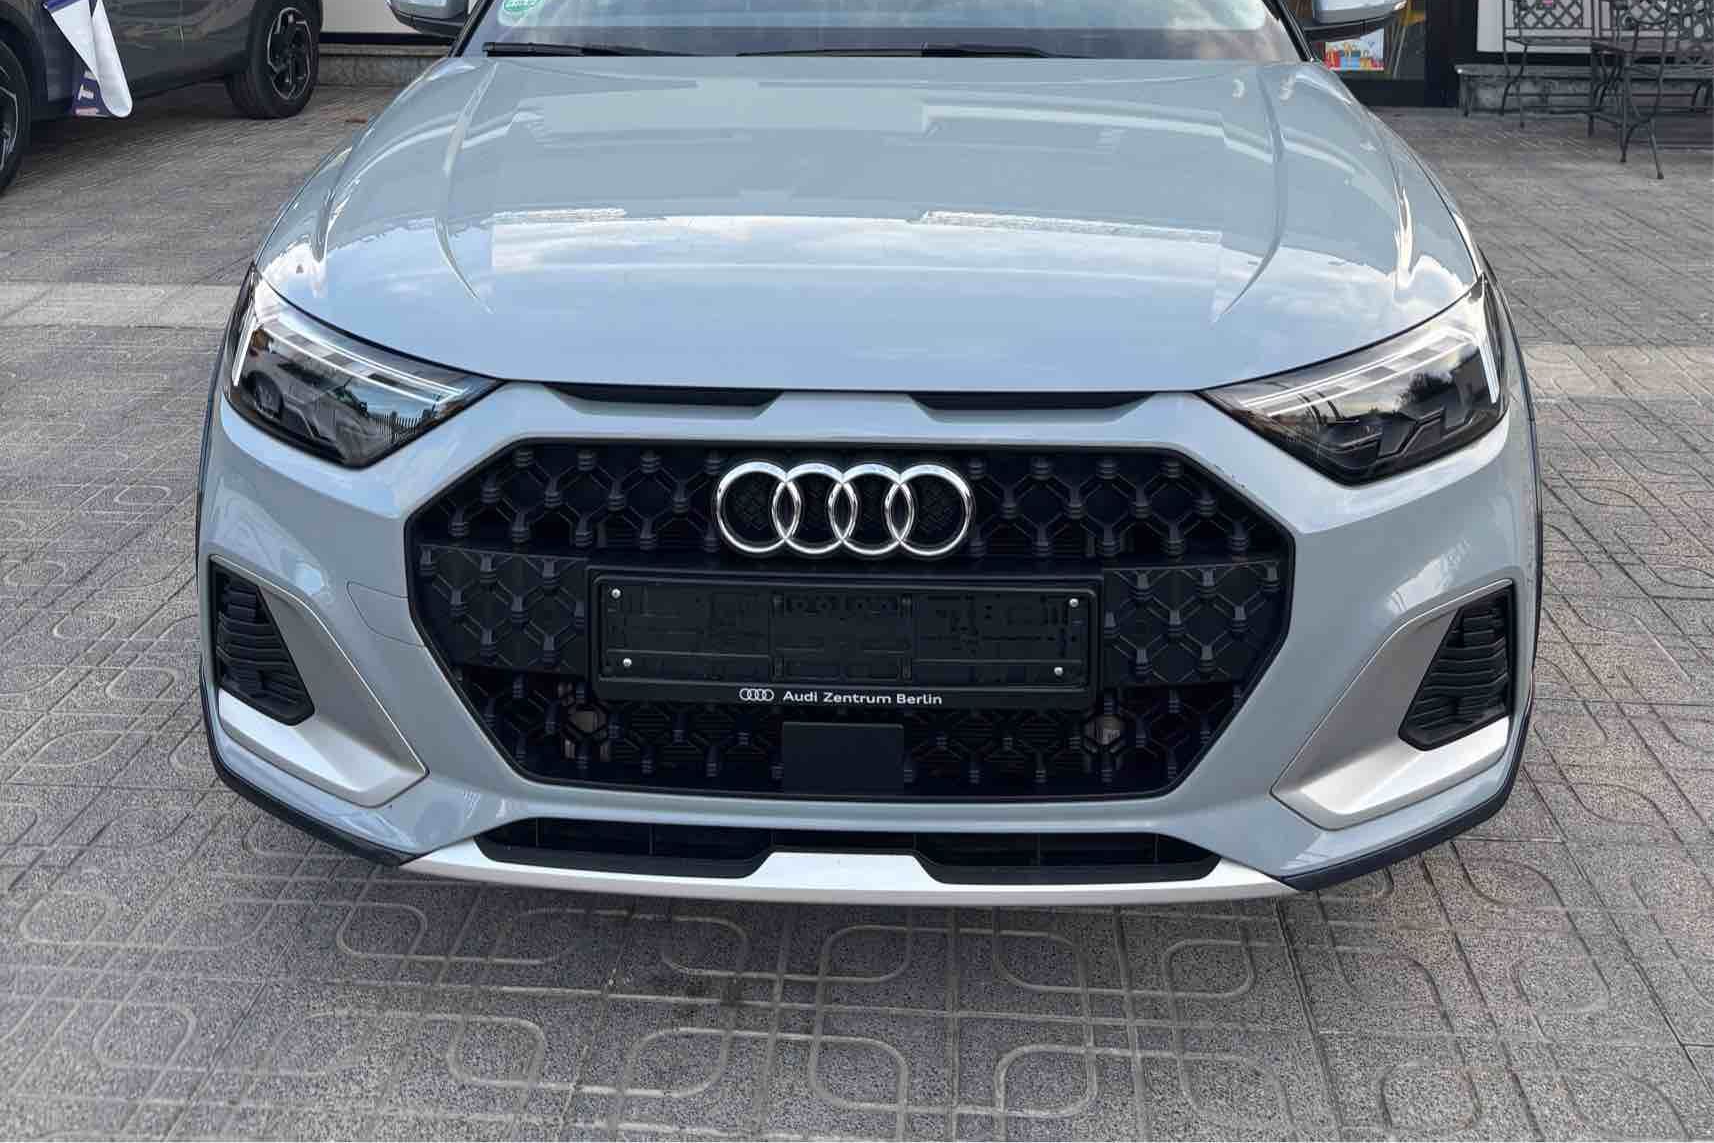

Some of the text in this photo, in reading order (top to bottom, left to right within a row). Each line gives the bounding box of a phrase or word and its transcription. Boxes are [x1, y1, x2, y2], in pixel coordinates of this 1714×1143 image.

[782, 690, 943, 706] Audi Zentrum Berlin
